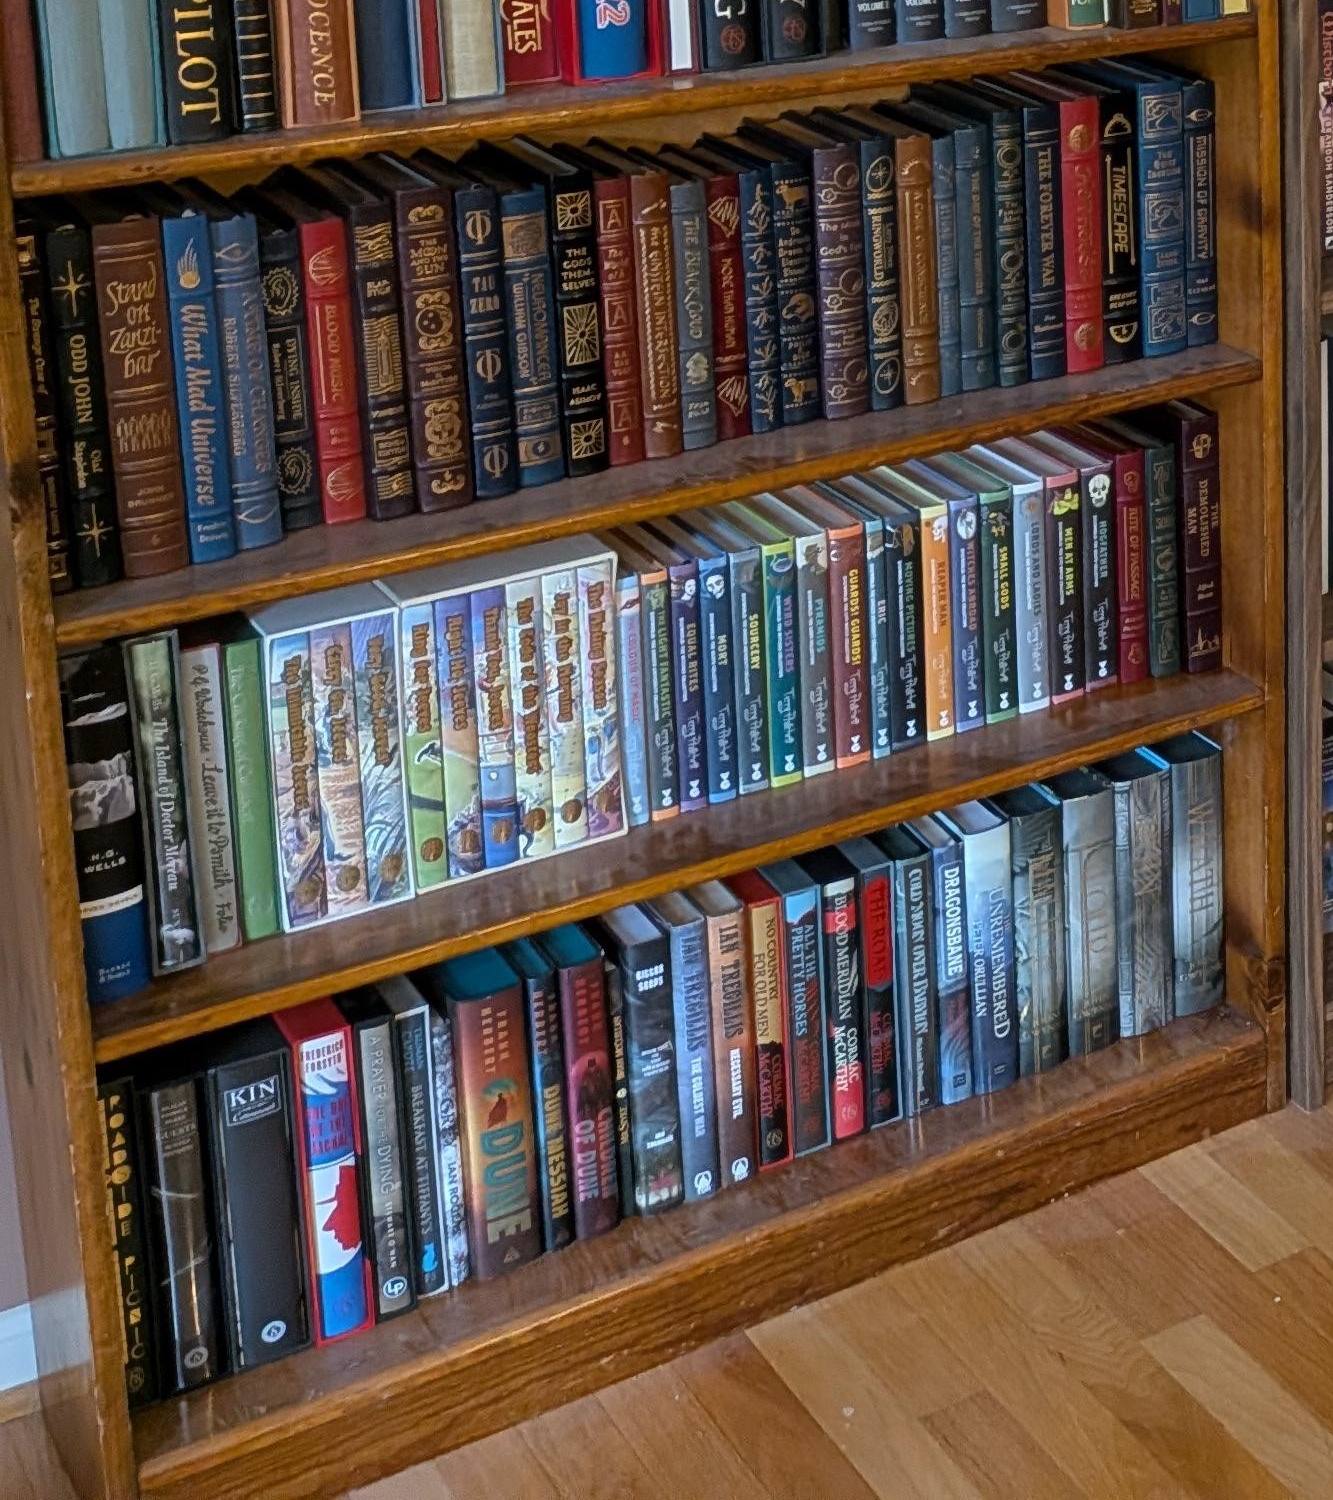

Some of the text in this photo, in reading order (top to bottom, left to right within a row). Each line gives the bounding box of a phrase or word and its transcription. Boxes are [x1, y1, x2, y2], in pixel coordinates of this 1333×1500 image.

[1112, 165, 1128, 253] TIMESCAPE
[68, 334, 92, 424] ODD JOHN
[180, 304, 216, 506] What Mad Universe
[717, 634, 728, 666] MORT
[749, 613, 760, 670] SOURCERY
[849, 569, 862, 665] GUARDS! GUARDS!
[876, 599, 886, 624] ERIC
[152, 718, 181, 891] The Island of Doctor Moreau
[834, 895, 852, 1020] BLOOD MERIDIAN
[944, 867, 961, 977] DRAGONSBANE
[228, 1079, 277, 1108] KIN
[833, 1025, 848, 1092] McCARTHY
[846, 1027, 859, 1083] CORMAC
[483, 1123, 531, 1244] DUNE
[543, 1083, 568, 1219] DUNE MESSIAH
